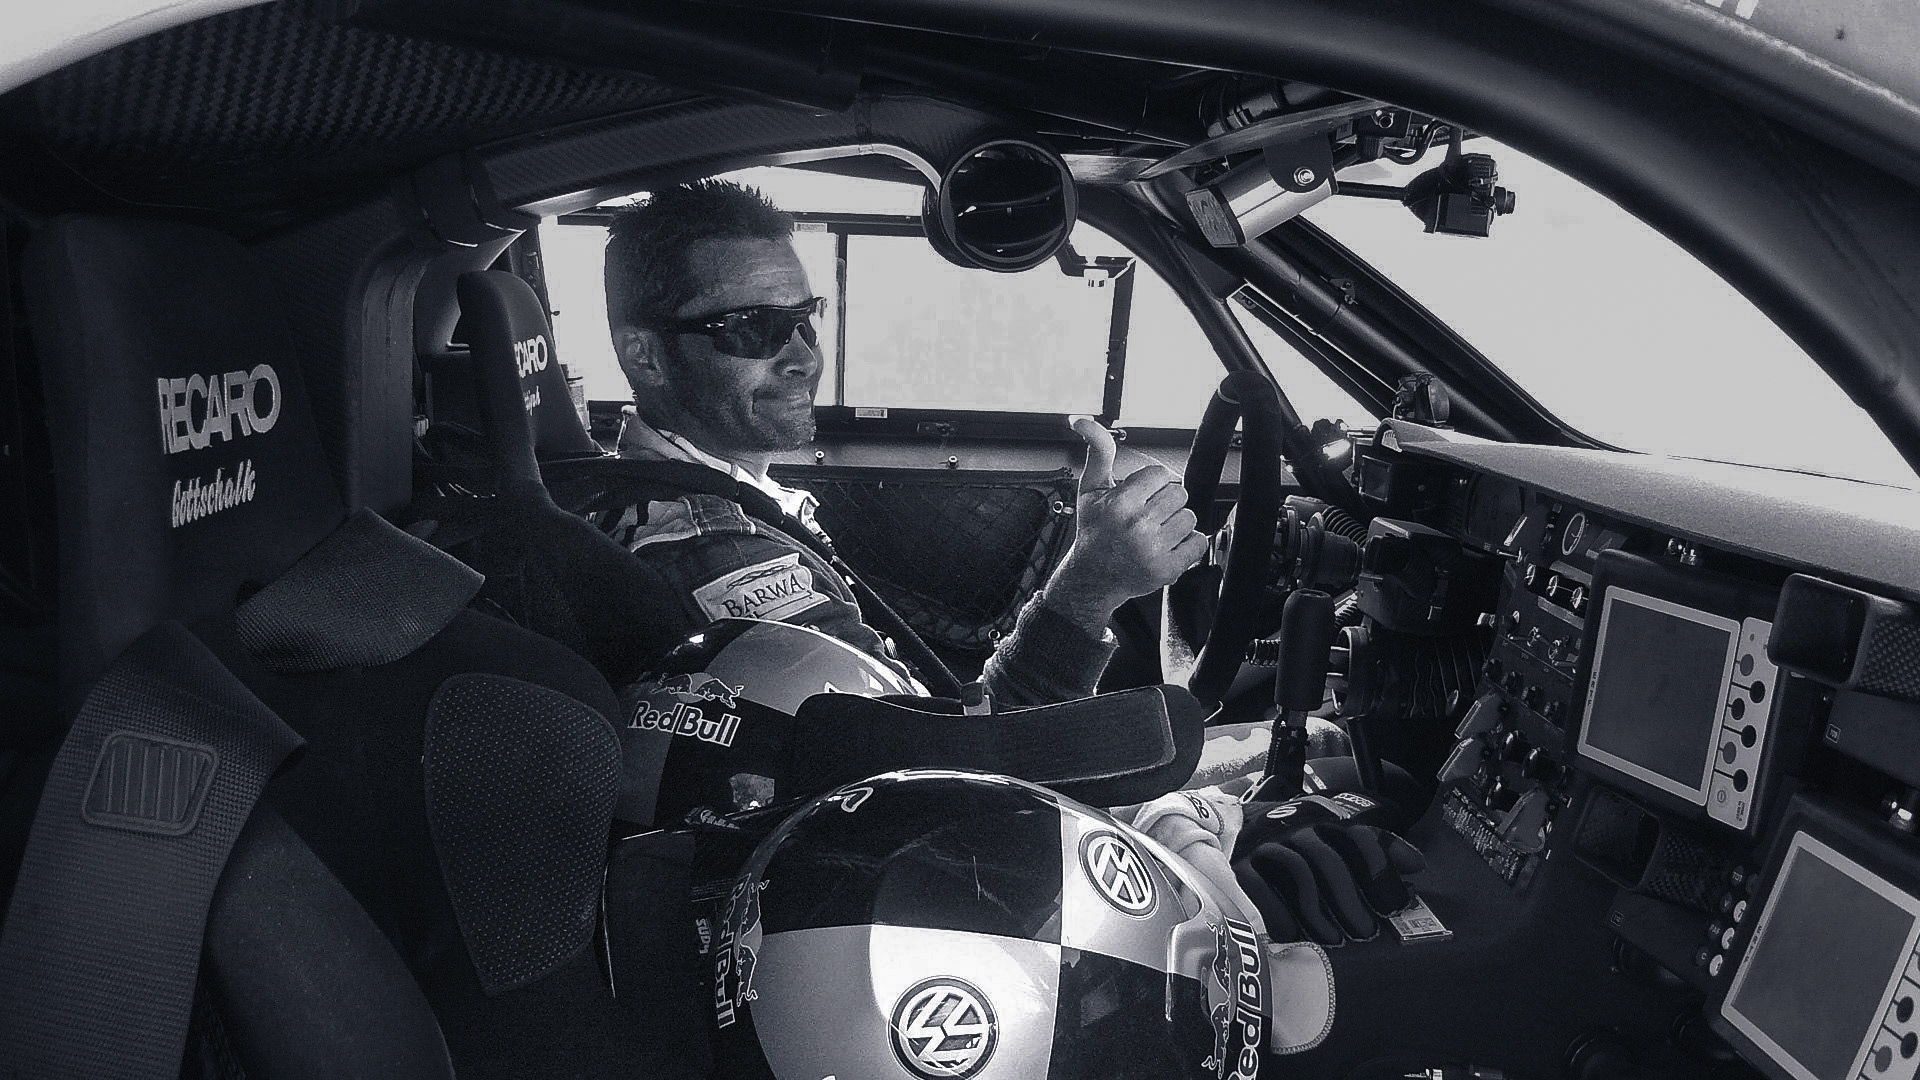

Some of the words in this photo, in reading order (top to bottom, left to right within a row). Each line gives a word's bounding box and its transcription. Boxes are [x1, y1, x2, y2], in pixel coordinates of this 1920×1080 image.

[157, 363, 282, 455] RECARO
[721, 572, 806, 618] BARWA
[627, 700, 682, 735] Red
[674, 703, 742, 748] Bull
[1223, 914, 1262, 1012] Bull
